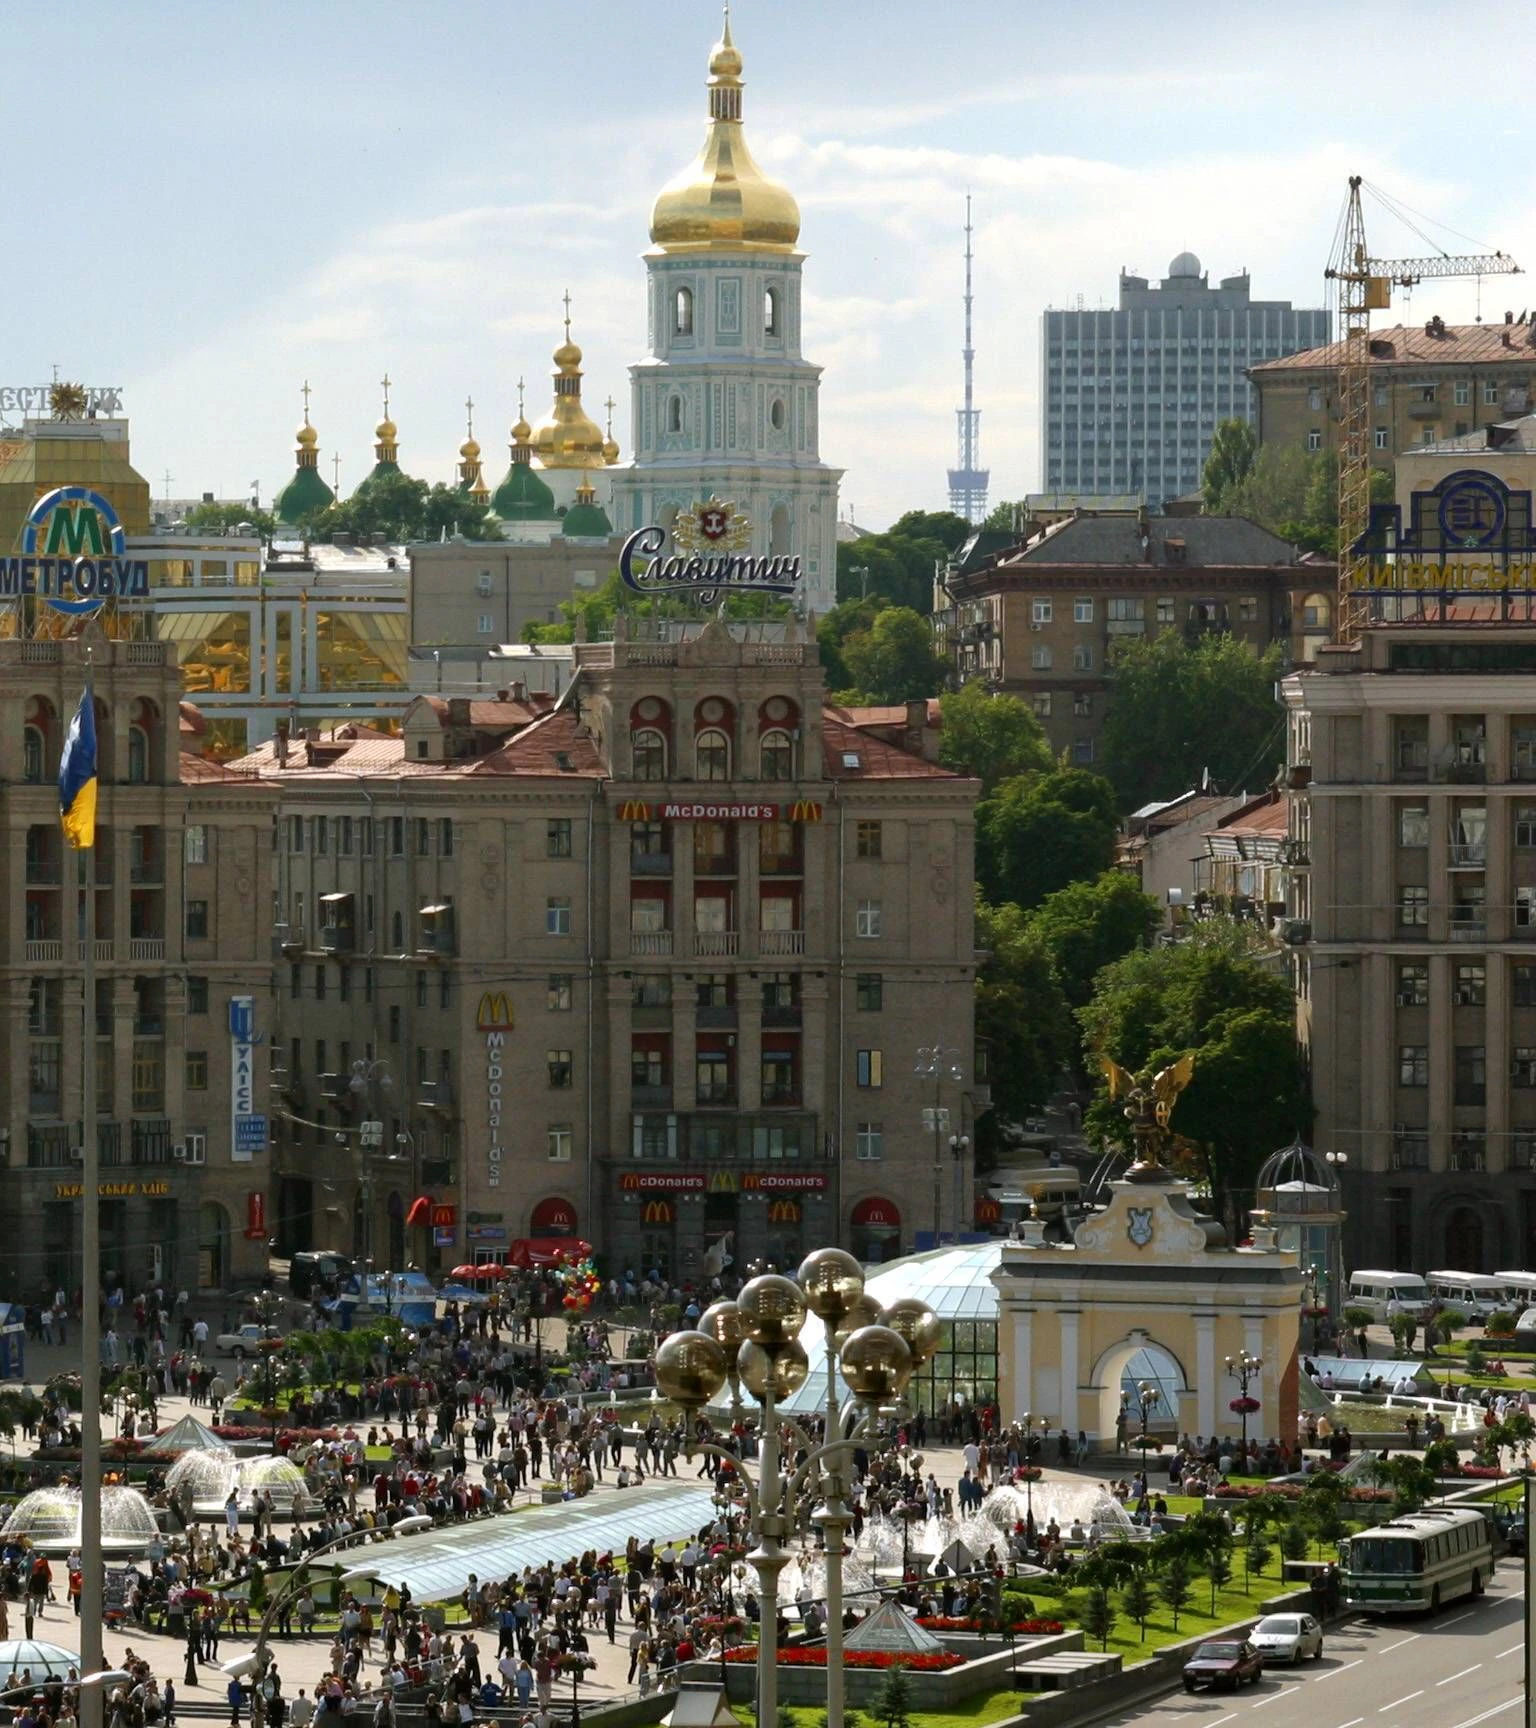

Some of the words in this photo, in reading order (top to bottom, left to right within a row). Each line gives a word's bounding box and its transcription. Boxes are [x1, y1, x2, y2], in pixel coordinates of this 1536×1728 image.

[619, 525, 802, 604] Славутич
[664, 804, 773, 818] McDonald's
[486, 1031, 504, 1178] McDonald's
